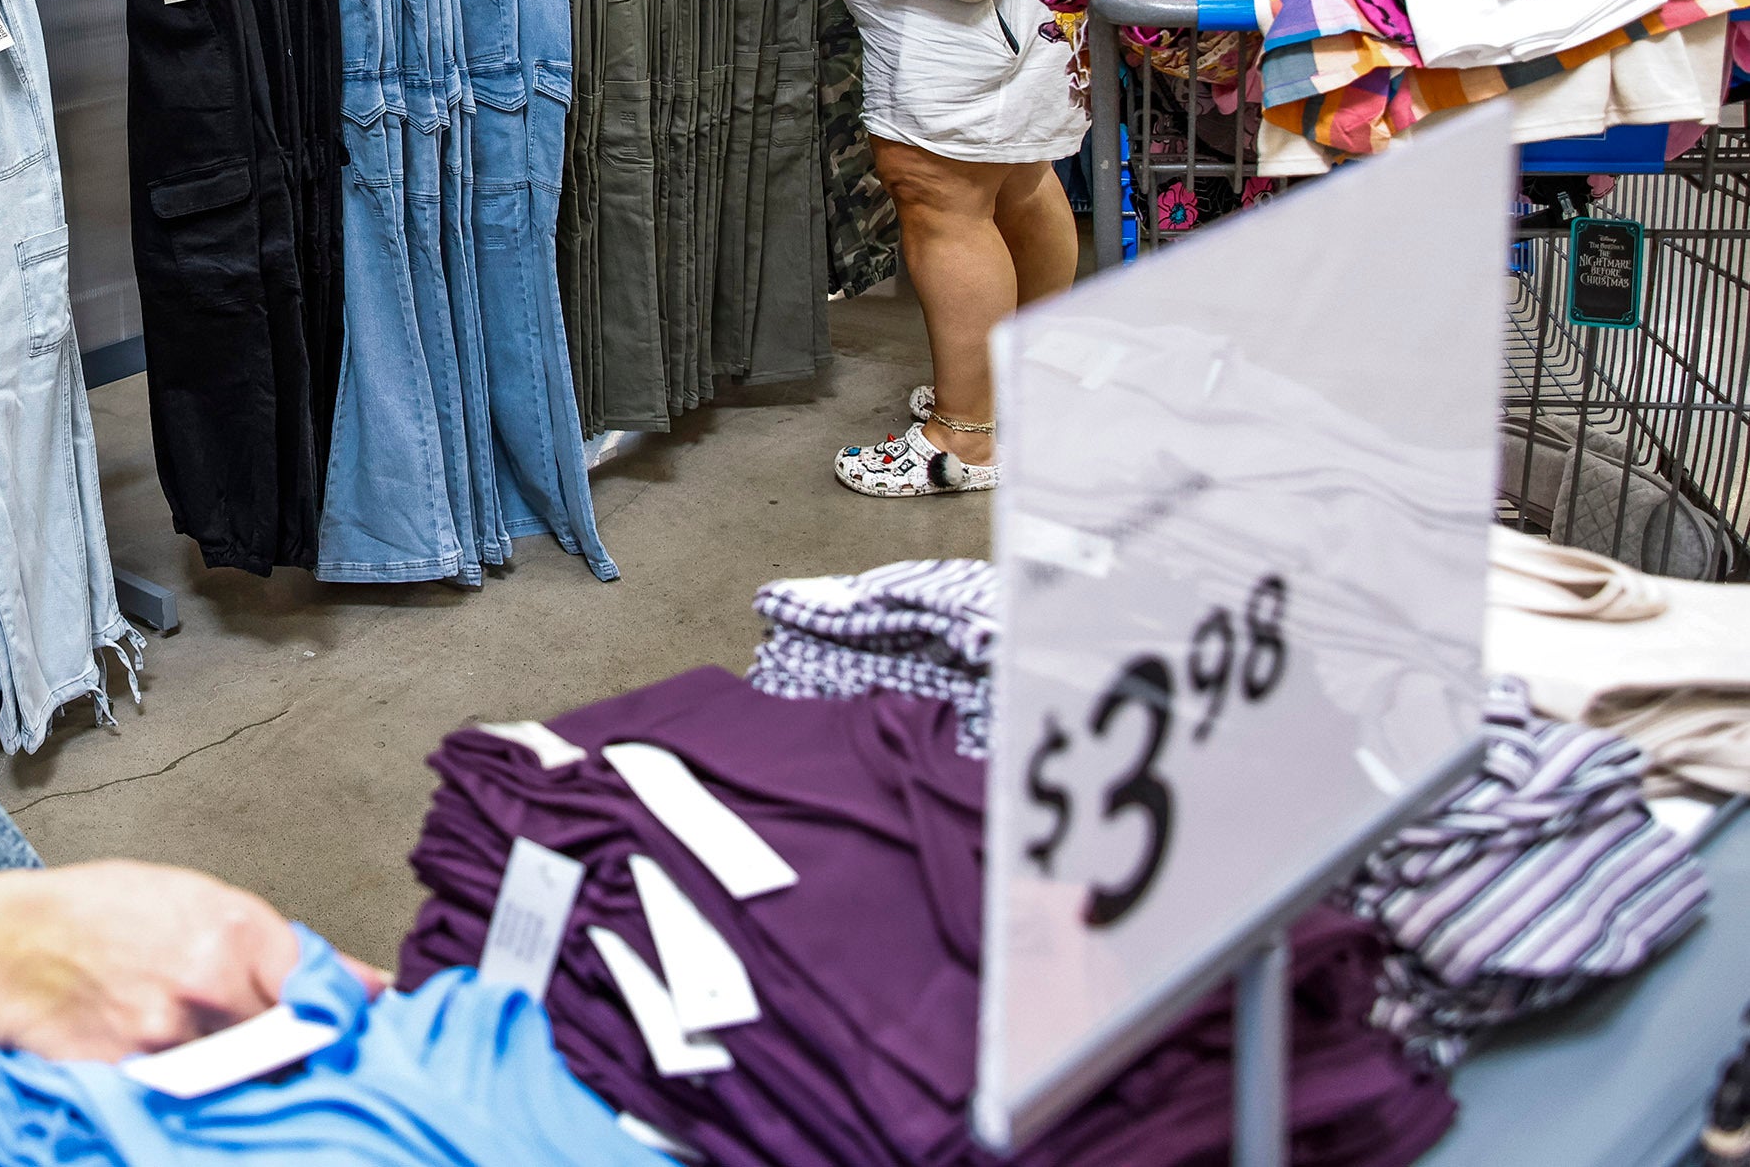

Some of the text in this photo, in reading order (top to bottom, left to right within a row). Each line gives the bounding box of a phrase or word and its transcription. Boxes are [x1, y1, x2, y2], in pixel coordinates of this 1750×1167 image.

[1579, 253, 1633, 270] NIGHTMARE
[1579, 272, 1630, 289] CHRISTMAS
[1590, 267, 1622, 278] BEFORE
